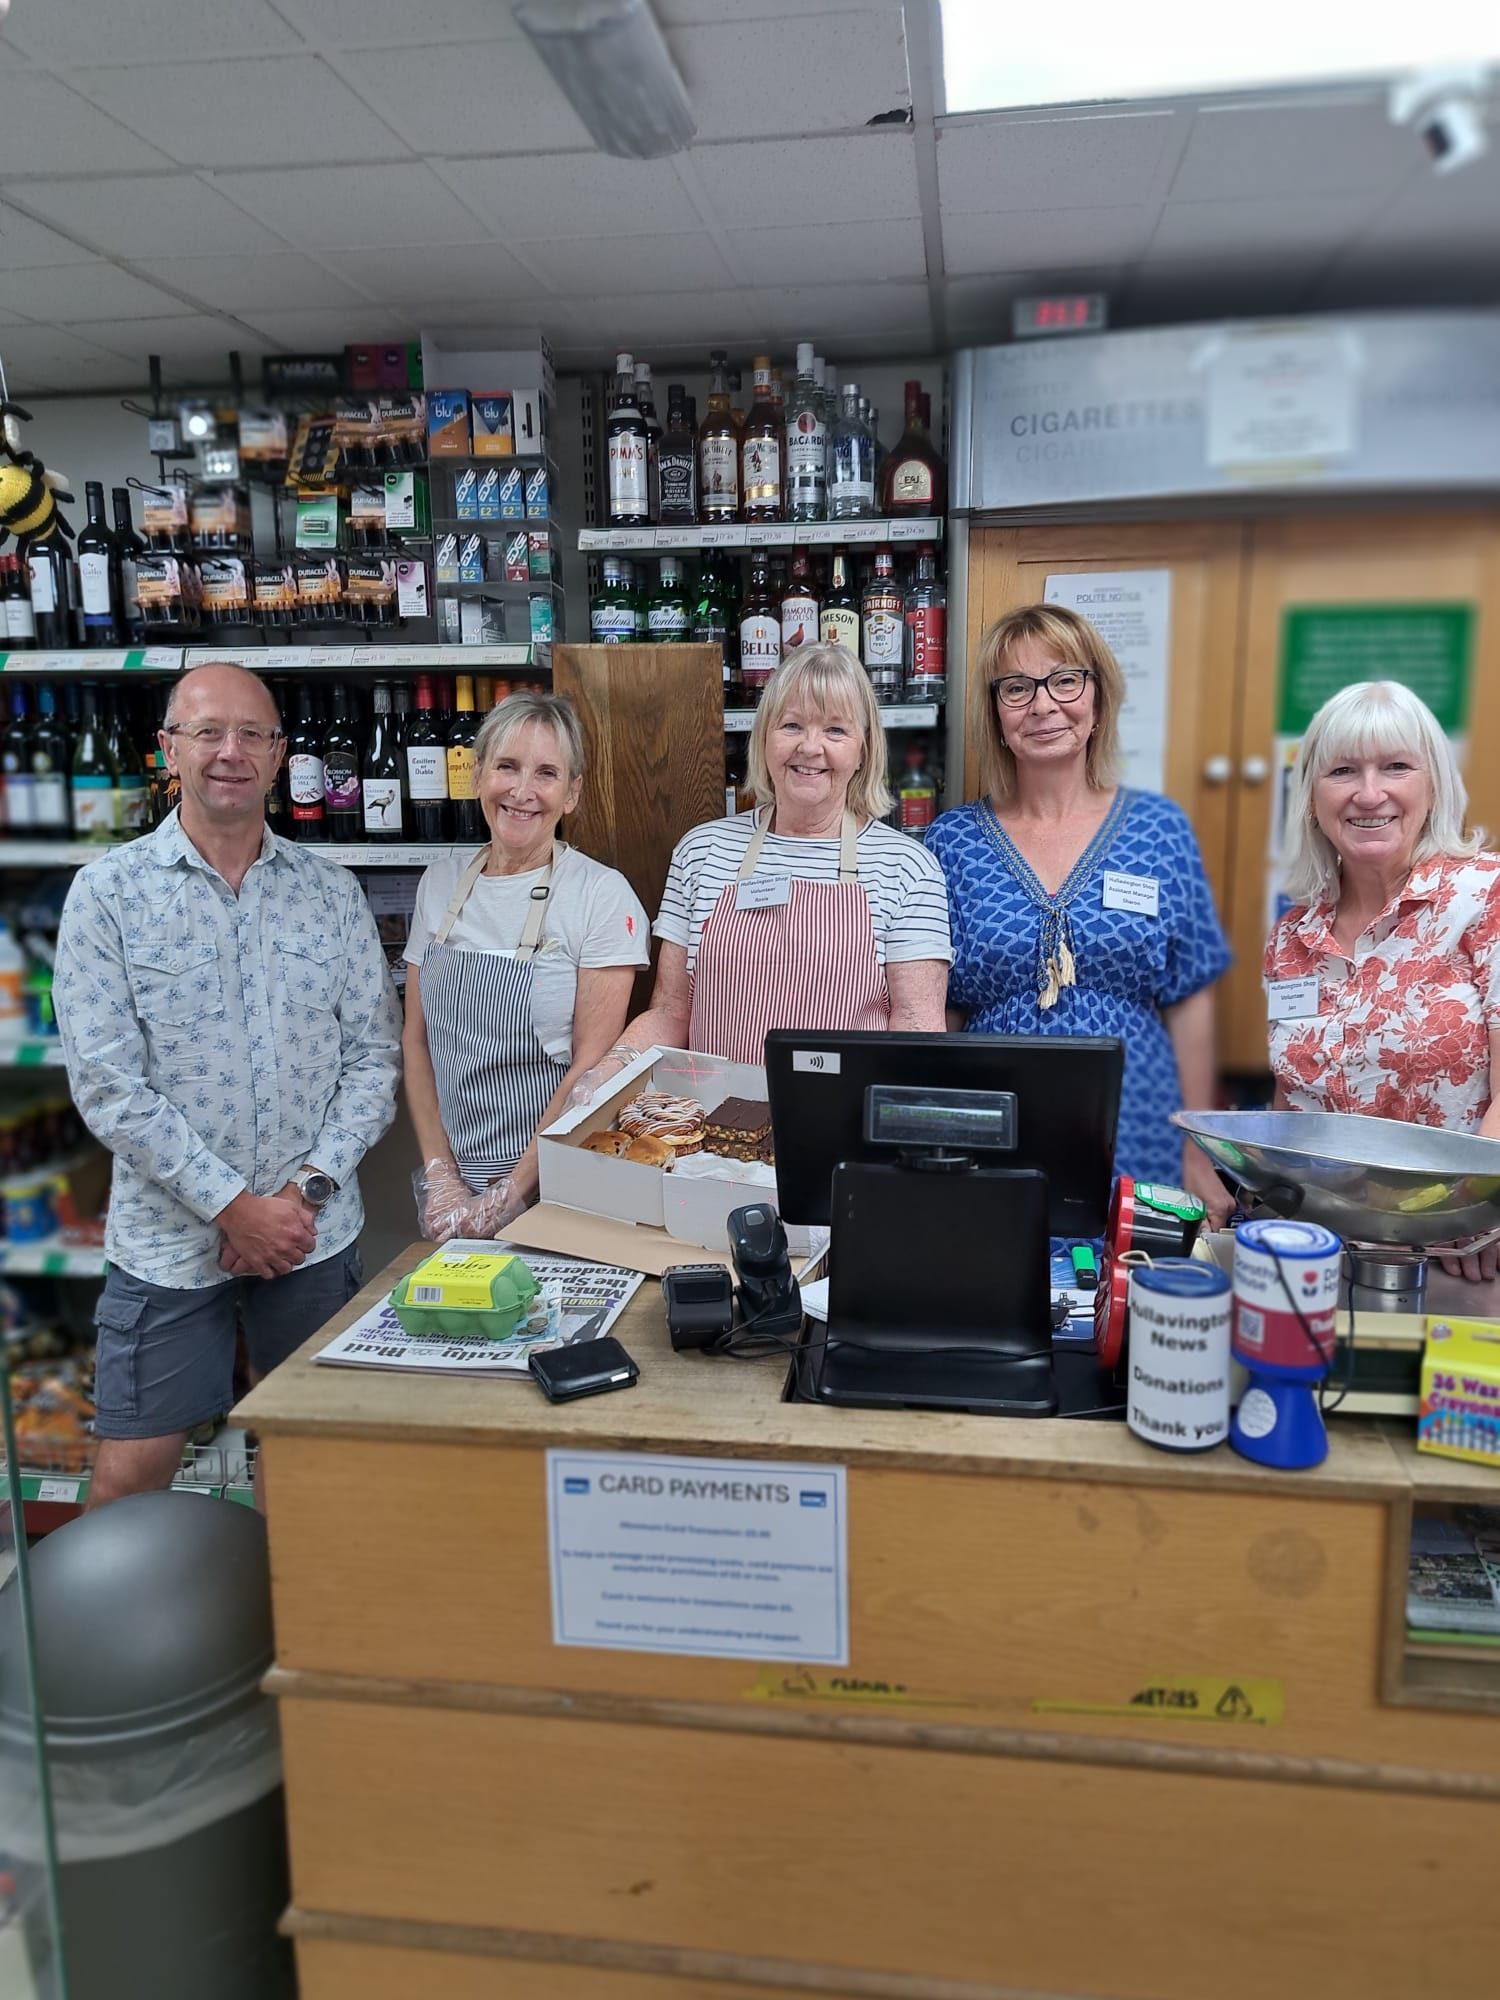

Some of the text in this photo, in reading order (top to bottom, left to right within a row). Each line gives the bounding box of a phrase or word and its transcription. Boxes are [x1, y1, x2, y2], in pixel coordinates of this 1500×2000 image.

[382, 408, 412, 417] DURACELL
[436, 405, 453, 418] blu
[484, 406, 499, 417] blu
[1010, 399, 1203, 437] CIGARETTES
[610, 444, 643, 461] PIMM'S
[137, 570, 167, 580] DURACELL
[203, 572, 232, 581] DURACELL
[298, 569, 327, 577] DURACELL
[349, 568, 380, 577] DURACELL
[255, 575, 283, 583] DURACELL
[1077, 591, 1142, 603] POLITE NOTICE
[783, 606, 815, 614] FAMOUS
[864, 599, 901, 611] SMIRNOFF
[916, 609, 925, 671] CHEKOV
[742, 641, 780, 656] BELL'S
[412, 757, 437, 765] Casillero
[327, 768, 352, 776] BLOSSOM
[552, 1266, 639, 1280] invaders
[594, 1278, 629, 1288] the
[561, 1286, 627, 1299] Minis
[568, 1298, 608, 1307] WORLD
[356, 1333, 378, 1341] the
[1151, 1330, 1208, 1352] News
[343, 1343, 514, 1361] Daily Mail
[1134, 1365, 1224, 1395] Donations
[1433, 1372, 1500, 1399] 36 Wax
[1132, 1406, 1225, 1441] Thank you
[599, 1473, 790, 1504] CARD PAYMENTS
